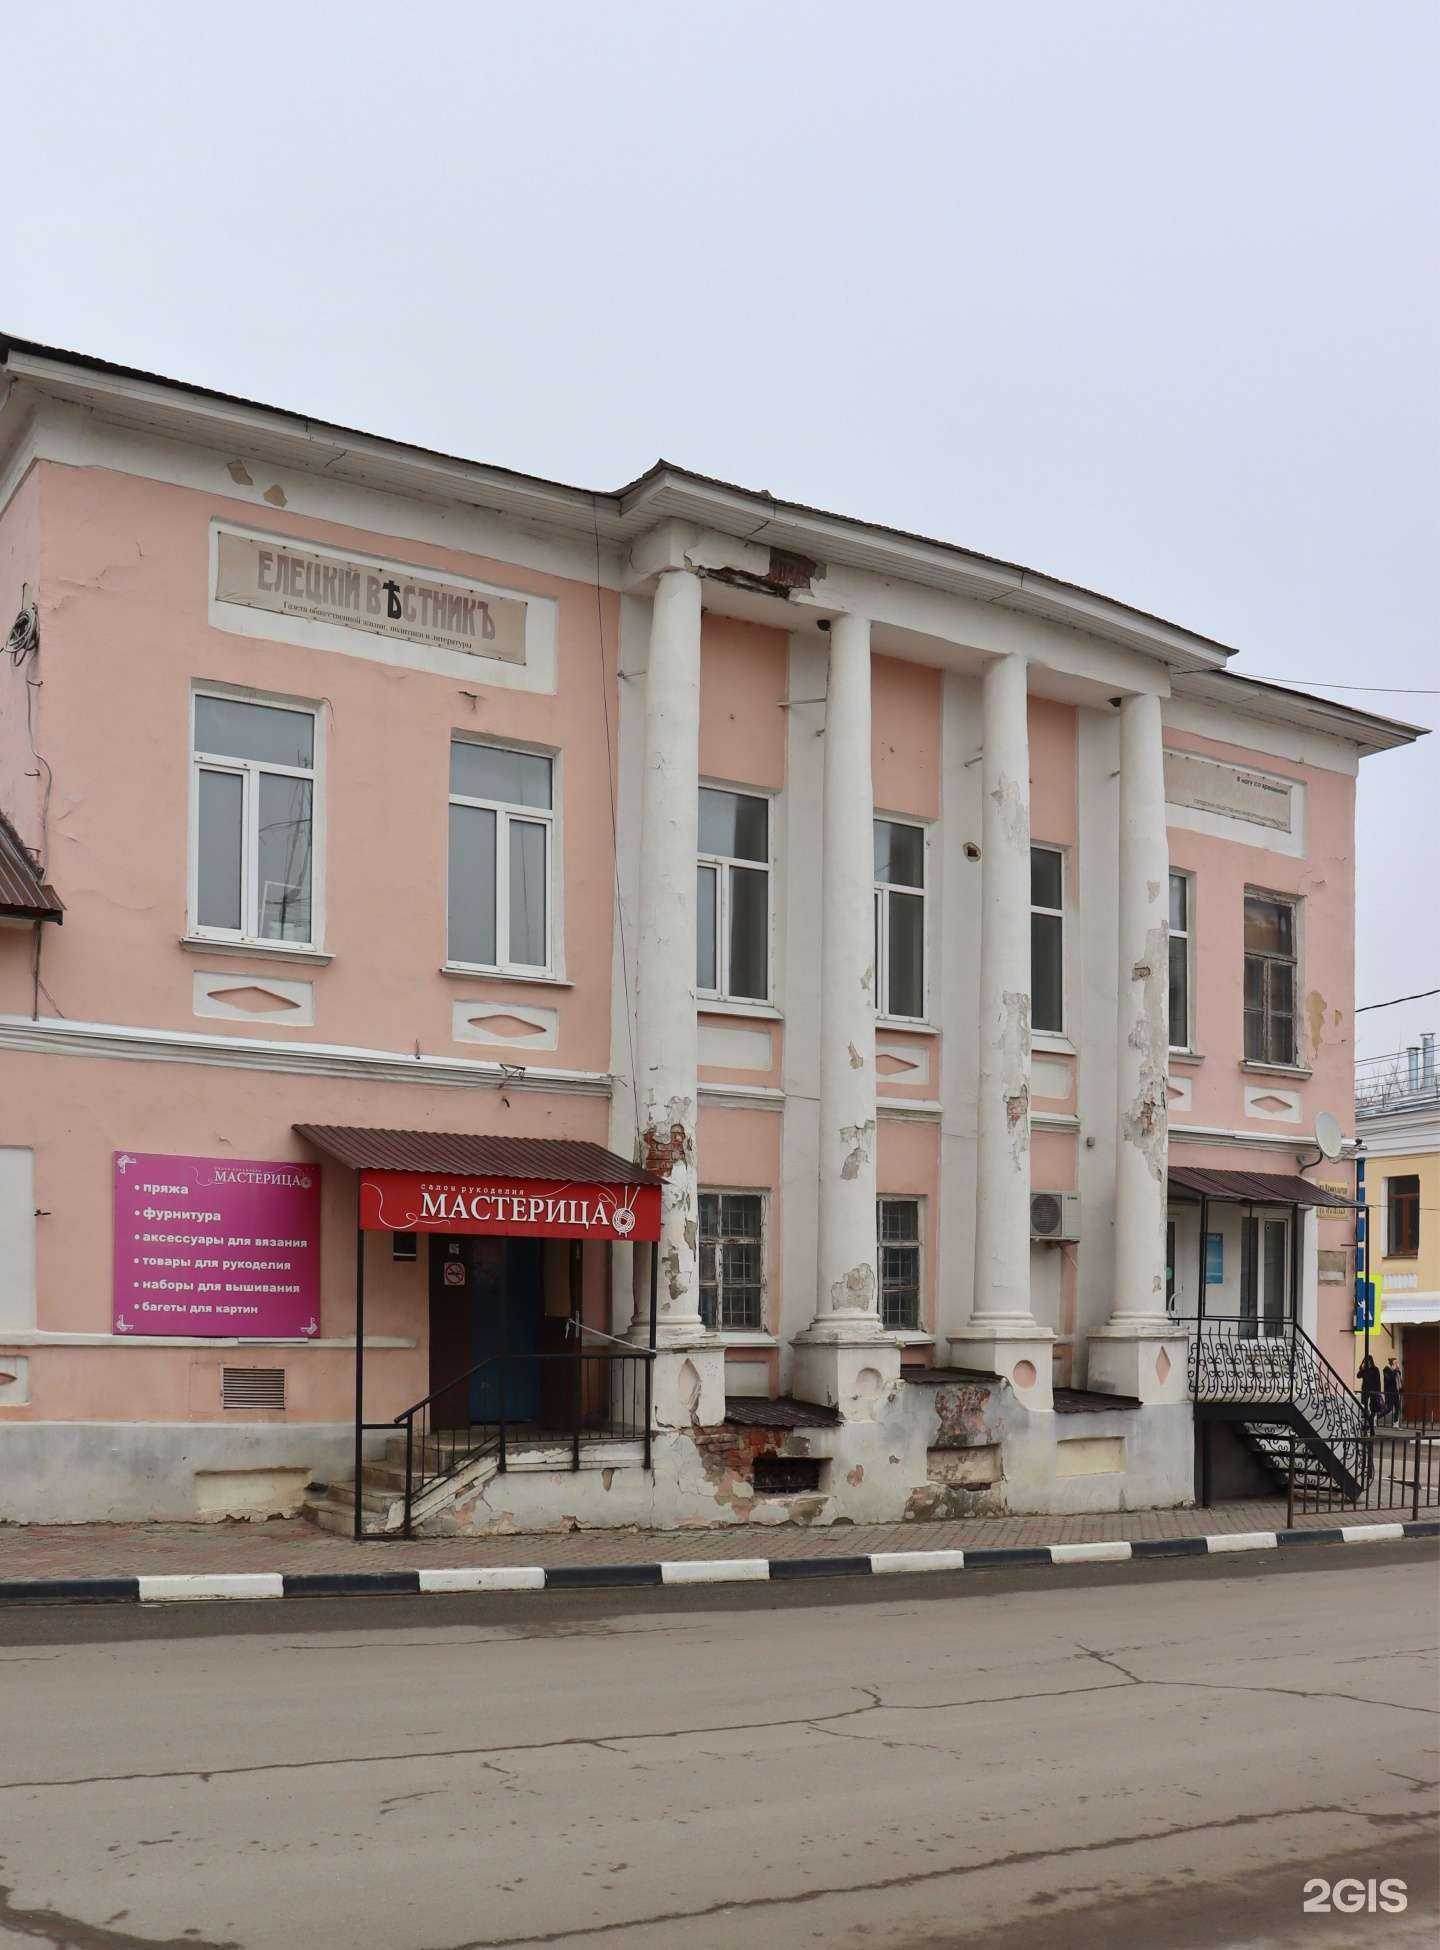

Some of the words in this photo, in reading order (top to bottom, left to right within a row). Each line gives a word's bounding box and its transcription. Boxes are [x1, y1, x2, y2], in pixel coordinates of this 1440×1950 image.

[215, 1170, 301, 1187] МАСТЕРИЦА
[143, 1183, 189, 1195] пряжа
[421, 1183, 456, 1192] салон
[461, 1186, 524, 1195] рукоделия
[143, 1206, 221, 1222] фурнитура
[420, 1193, 610, 1229] МАСТЕРИЦА
[143, 1233, 224, 1246] аксессуары
[228, 1237, 251, 1247] для
[255, 1239, 308, 1248] вязания
[143, 1257, 191, 1269] товары
[195, 1260, 219, 1269] для
[223, 1261, 291, 1270] рукоделия
[143, 1279, 194, 1292] наборы
[198, 1283, 221, 1292] для
[226, 1284, 300, 1293] вышивания
[142, 1302, 187, 1312] багеты
[190, 1305, 212, 1314] для
[216, 1306, 258, 1315] картин
